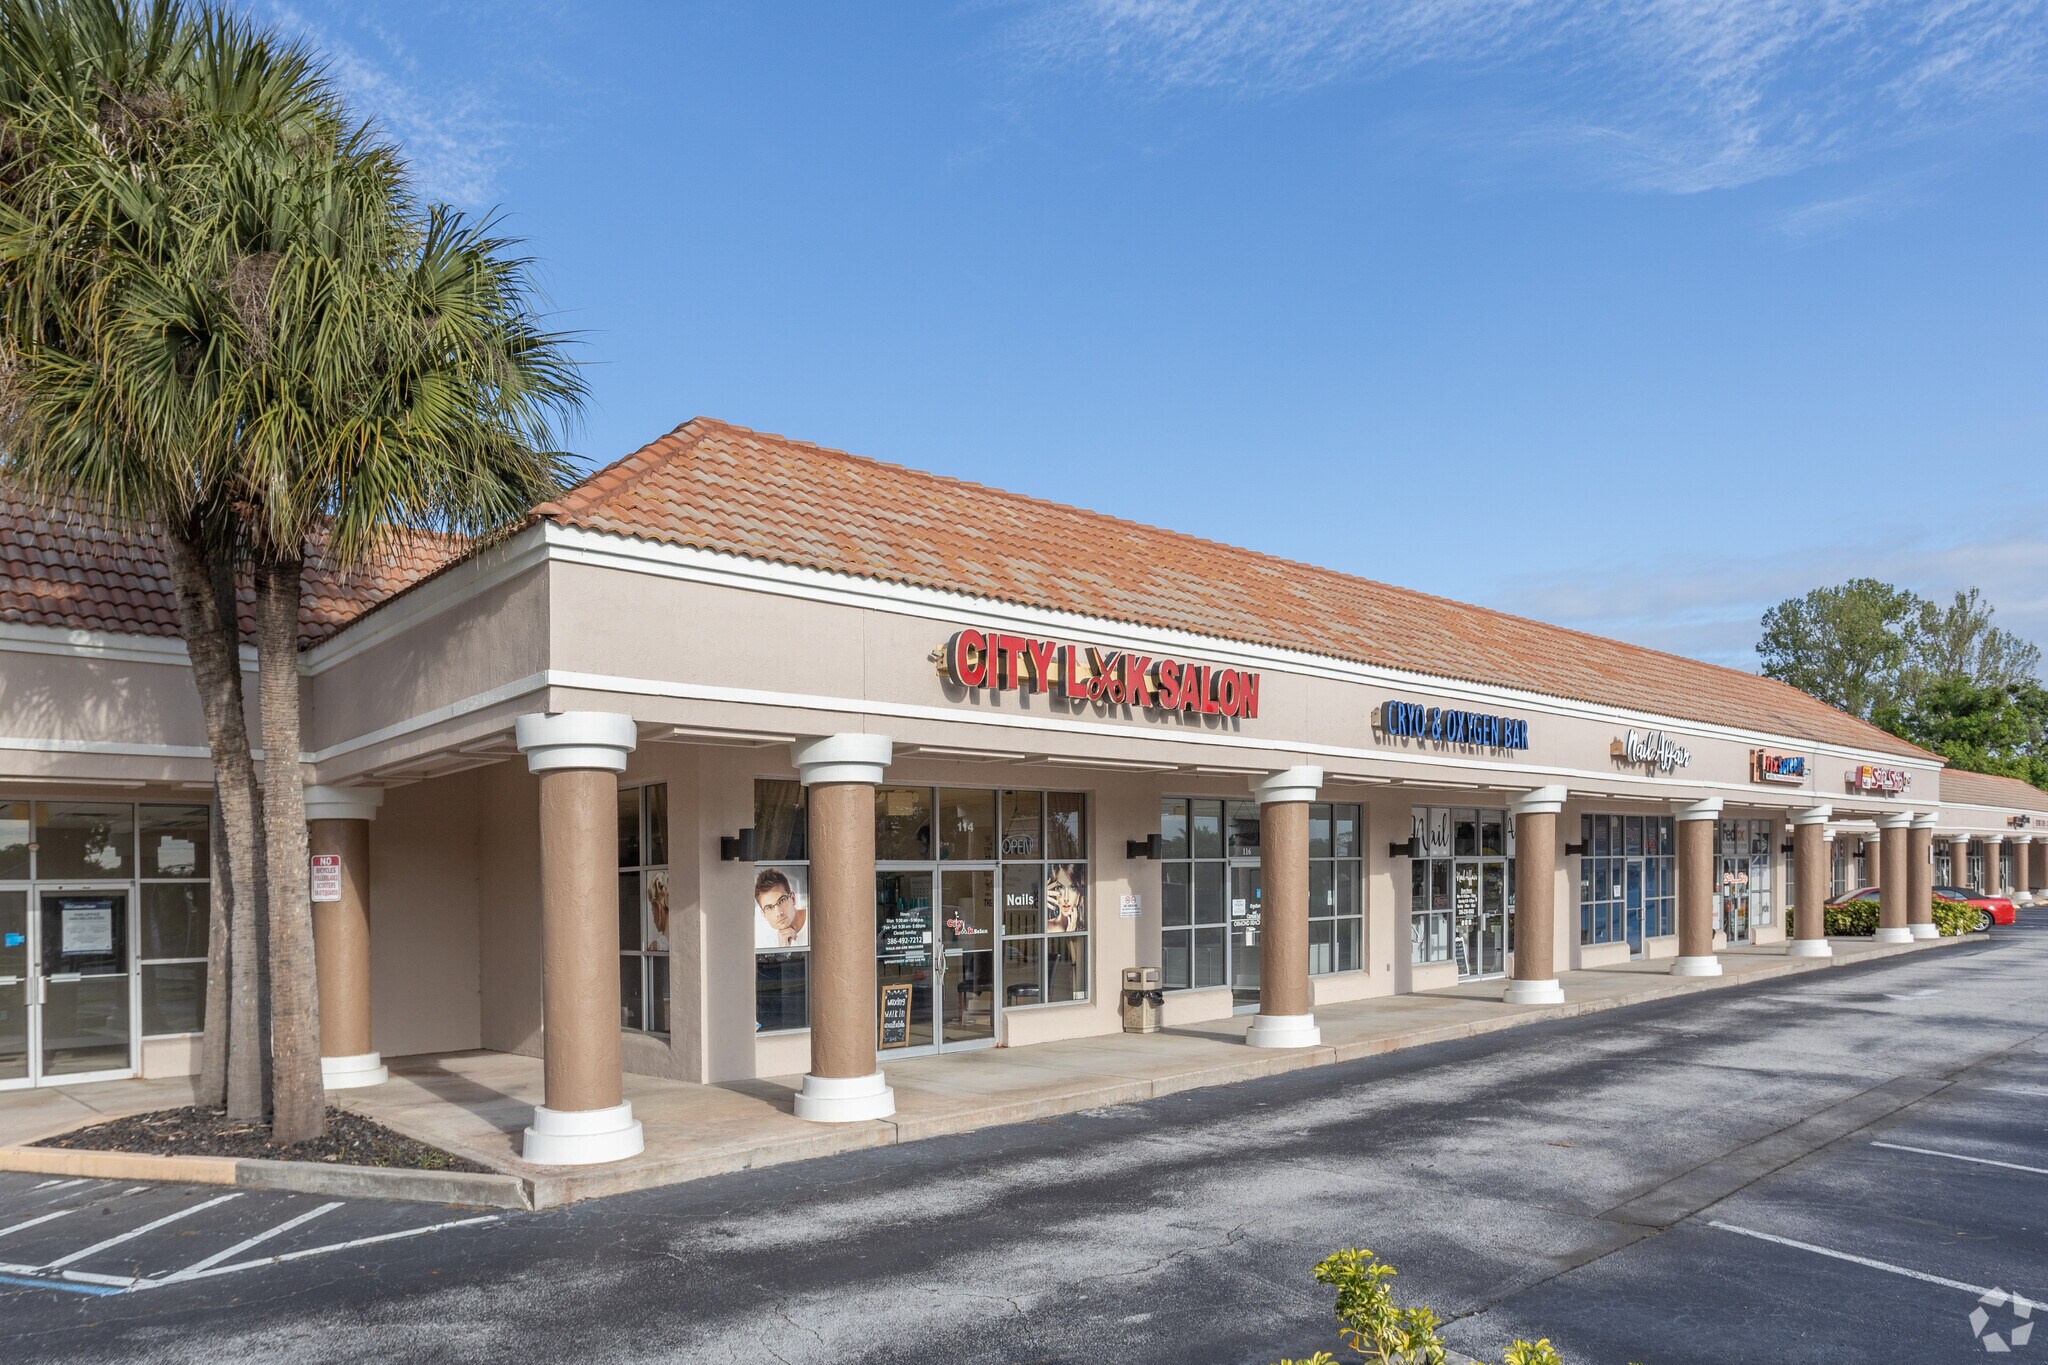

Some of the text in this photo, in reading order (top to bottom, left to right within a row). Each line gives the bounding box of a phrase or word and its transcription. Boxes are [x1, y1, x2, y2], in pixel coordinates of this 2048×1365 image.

[956, 628, 1056, 694] CITY
[1158, 658, 1261, 719] SALON
[1387, 699, 1529, 750] CRYO & OXYGEN BAR
[1627, 728, 1692, 771] Nail Affair
[957, 822, 974, 832] 114
[1002, 838, 1033, 855] OPEN
[1242, 847, 1252, 856] 116
[319, 857, 332, 866] NO
[1006, 893, 1034, 906] Nails
[887, 936, 923, 945] 386-492-7212
